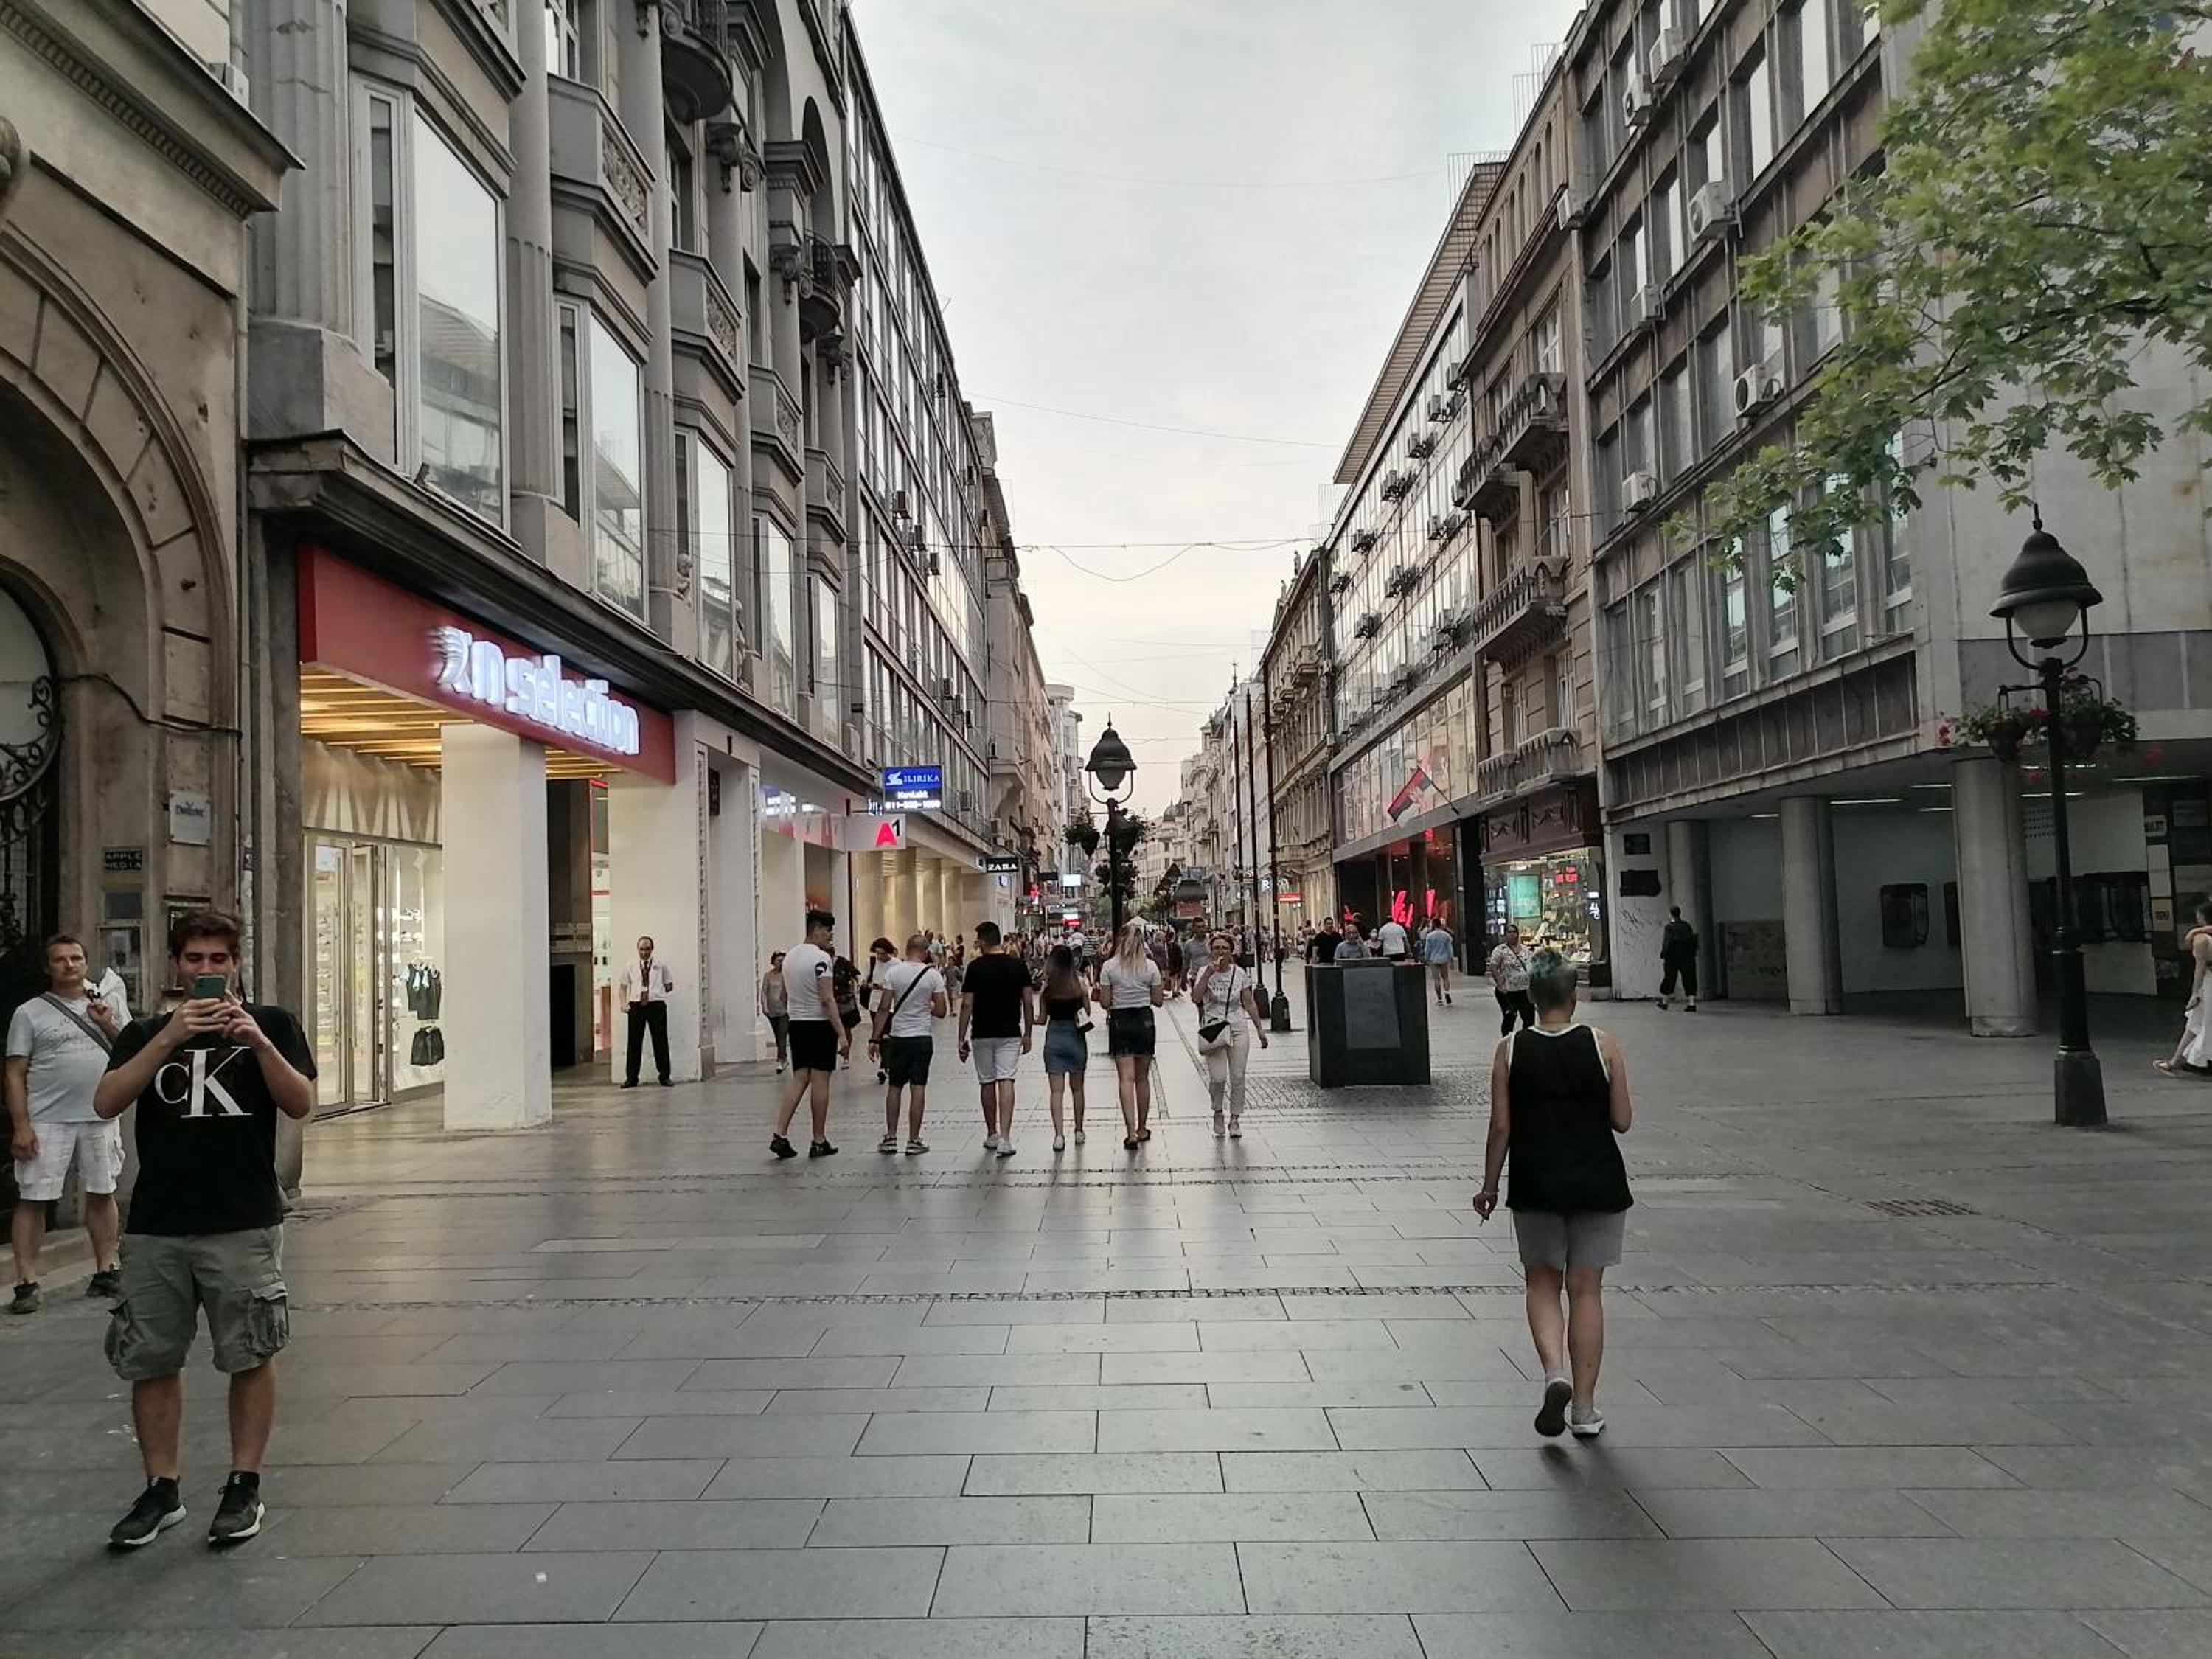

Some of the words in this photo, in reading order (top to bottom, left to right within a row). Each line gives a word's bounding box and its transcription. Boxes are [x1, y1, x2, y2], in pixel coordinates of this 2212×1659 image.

[903, 774, 940, 783] ILIRIKA
[875, 818, 900, 848] A1
[987, 863, 1018, 872] ZARA
